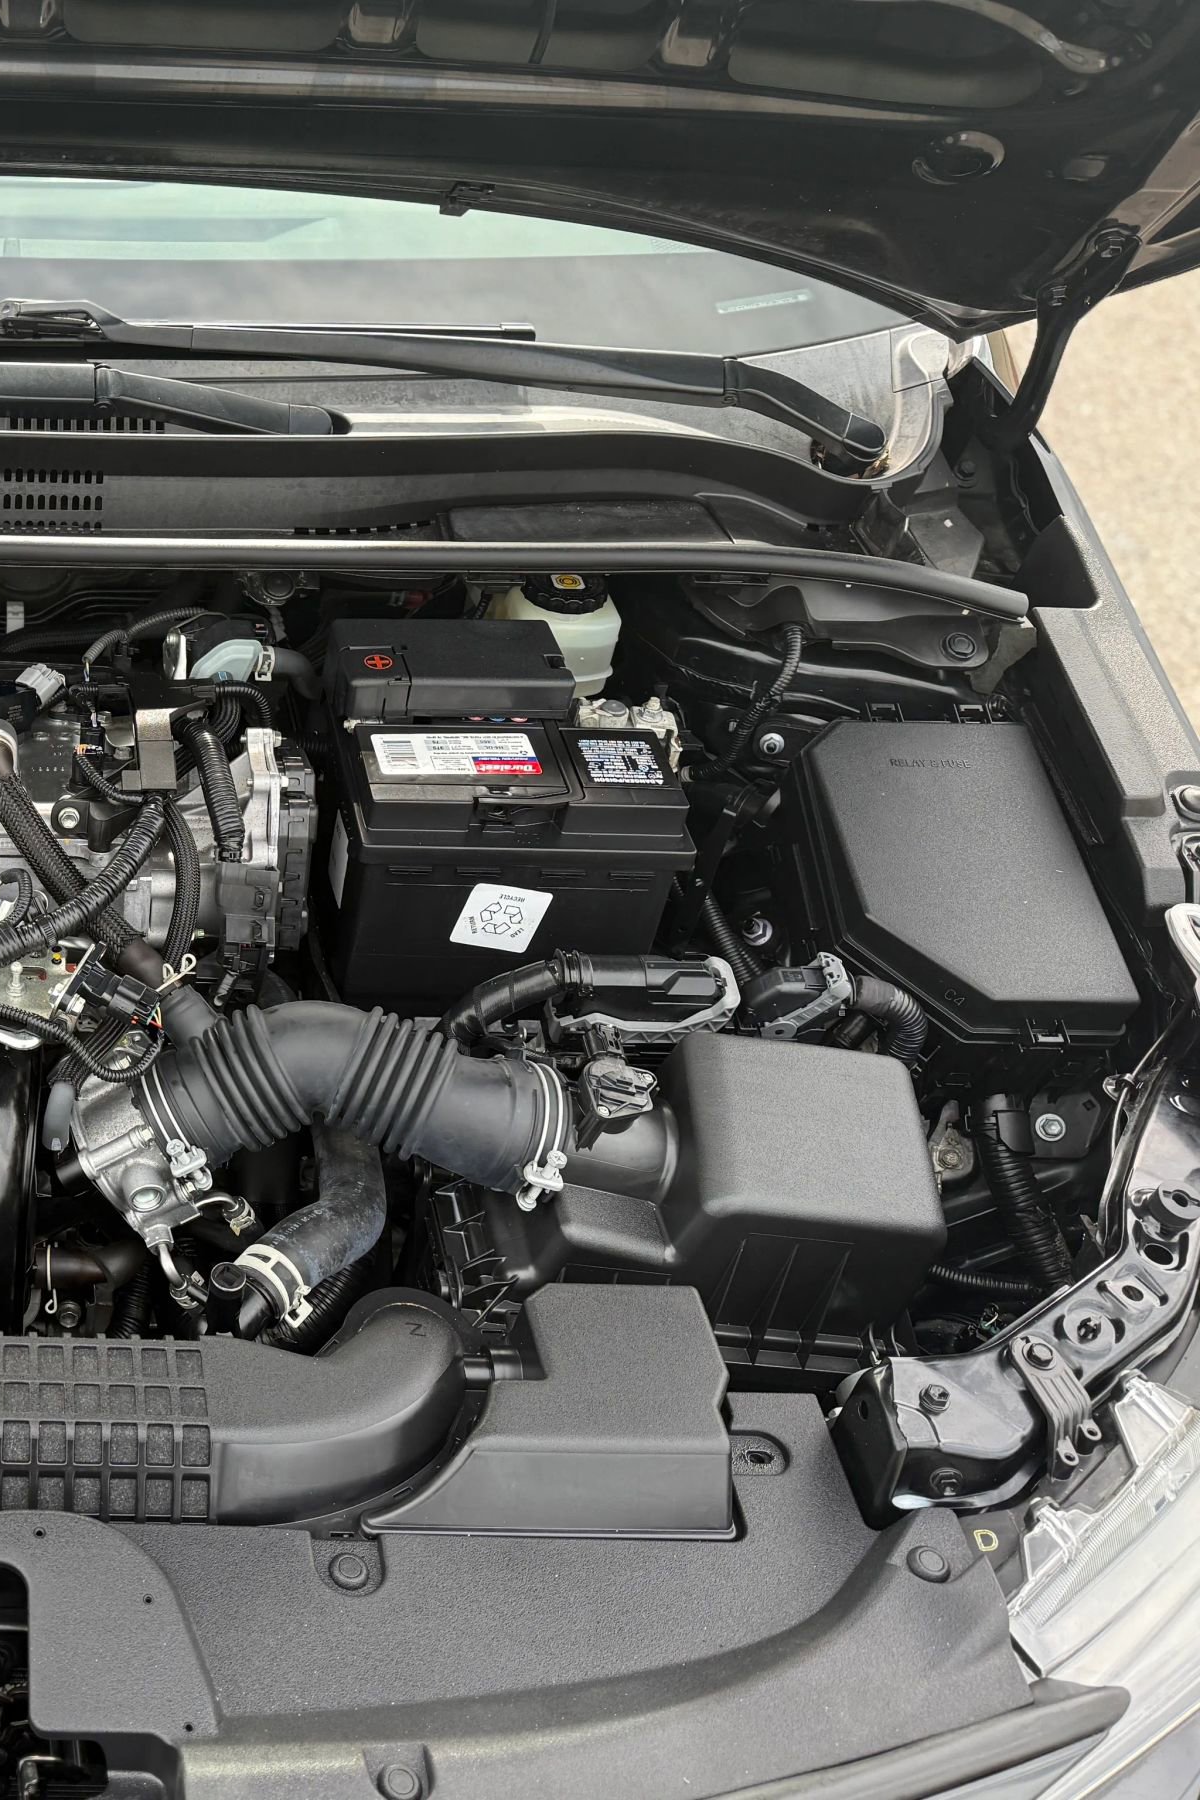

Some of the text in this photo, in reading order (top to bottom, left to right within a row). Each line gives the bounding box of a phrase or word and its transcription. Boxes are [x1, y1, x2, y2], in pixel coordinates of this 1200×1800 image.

[479, 764, 536, 772] Duralast
[889, 758, 926, 768] RELAY
[941, 759, 972, 769] FUSE
[499, 894, 525, 902] RECYCLE
[510, 928, 524, 938] LEAD
[973, 1529, 999, 1552] D
